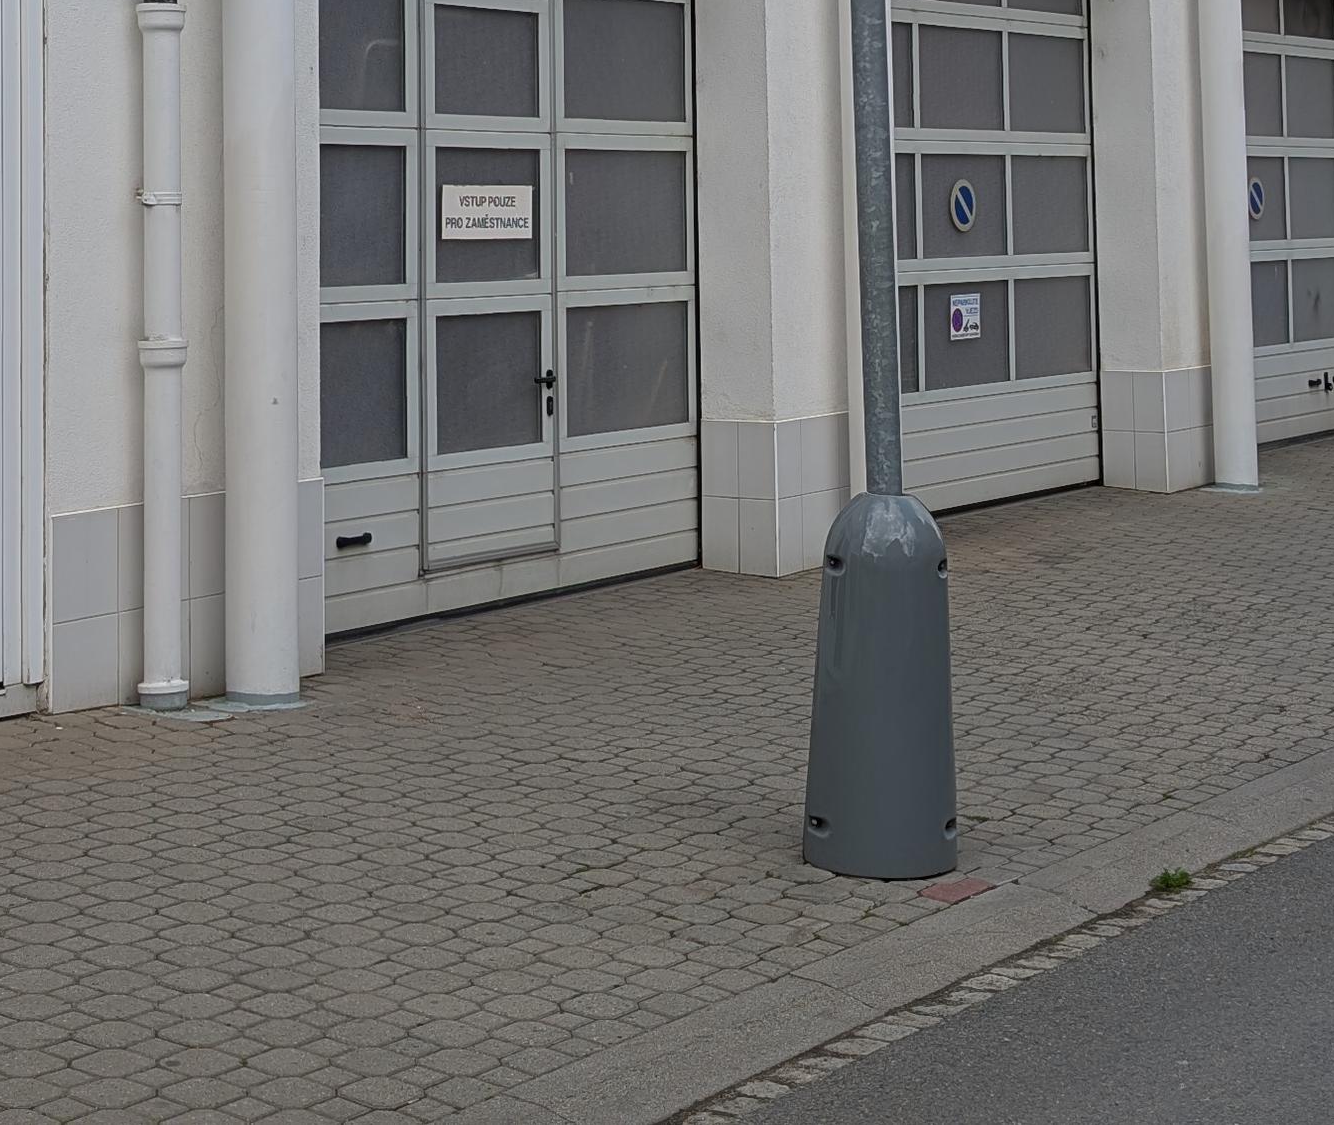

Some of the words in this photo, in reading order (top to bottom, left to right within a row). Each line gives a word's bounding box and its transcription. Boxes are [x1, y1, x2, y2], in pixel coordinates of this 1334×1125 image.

[459, 196, 487, 207] VSTUP
[488, 196, 516, 207] POUZE
[445, 217, 463, 228] PRO
